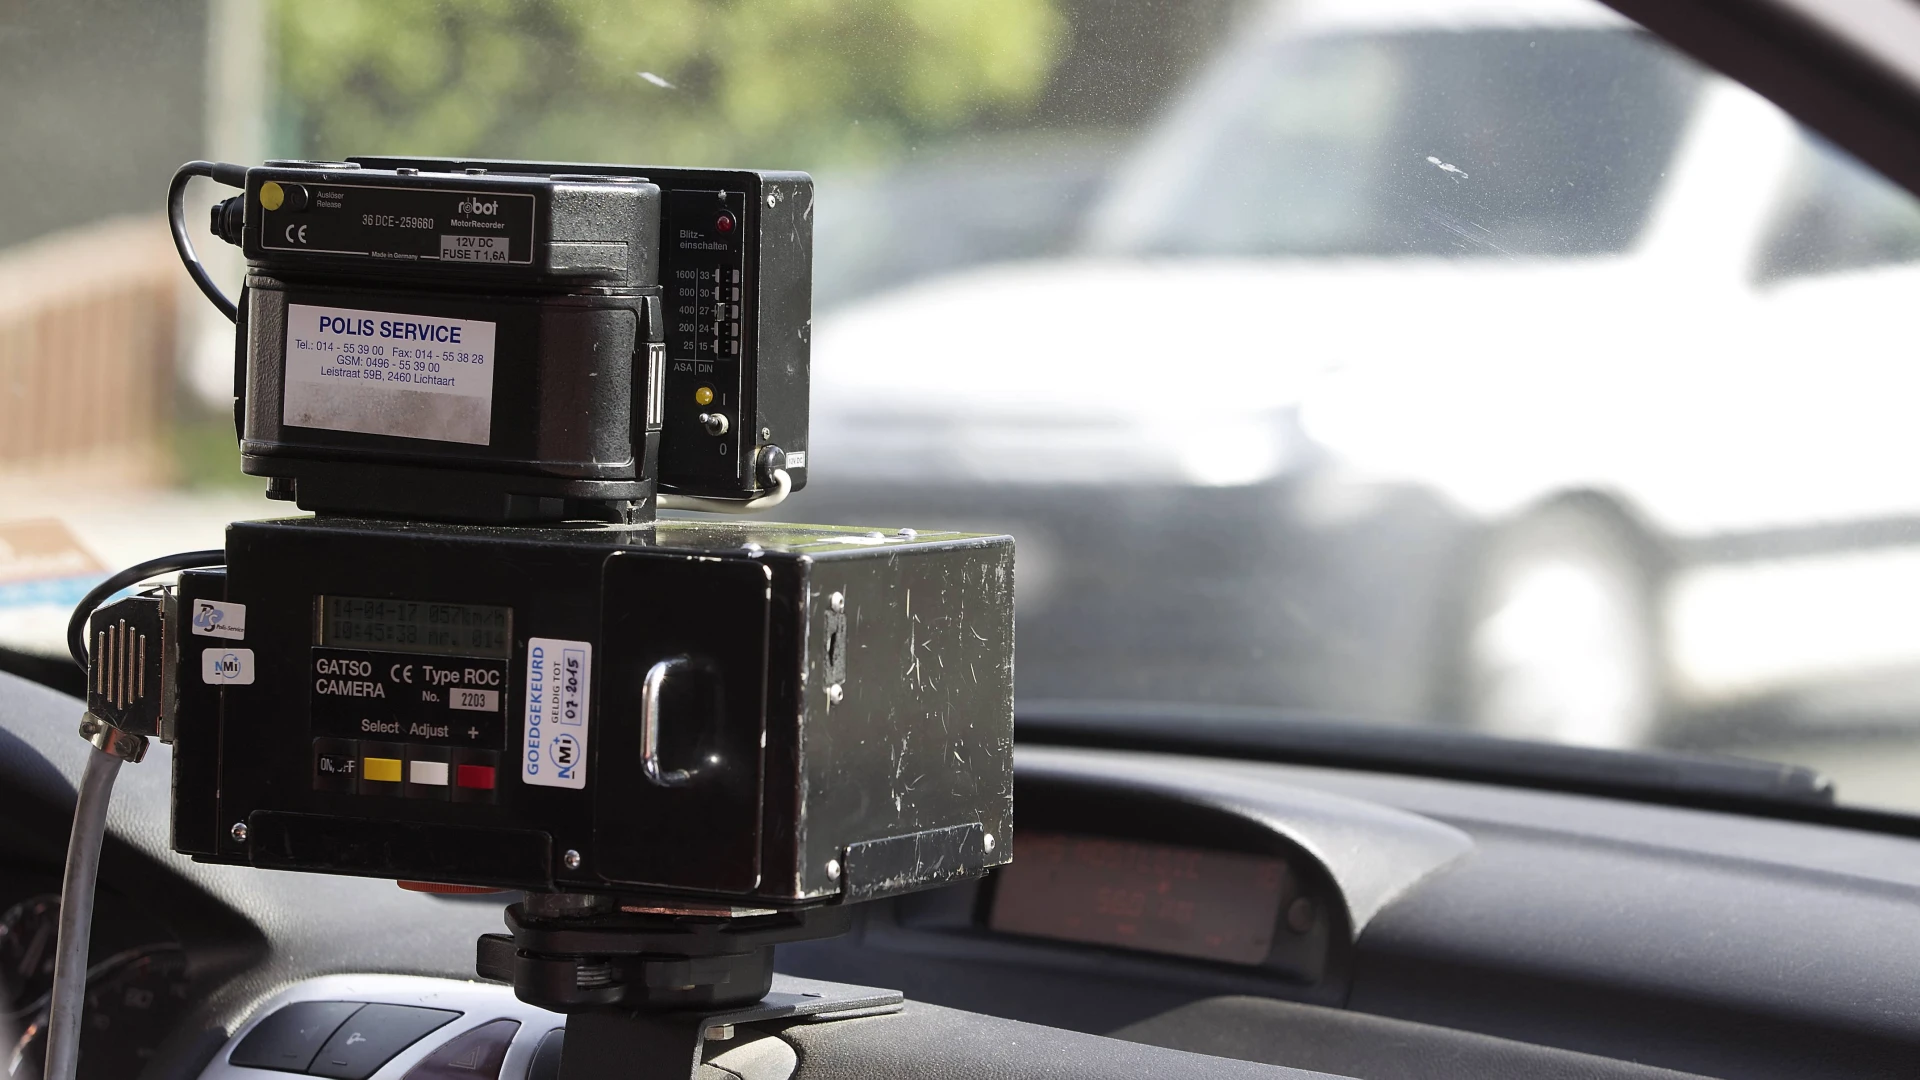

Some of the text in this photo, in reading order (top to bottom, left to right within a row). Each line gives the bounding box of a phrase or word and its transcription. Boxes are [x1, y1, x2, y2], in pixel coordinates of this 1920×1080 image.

[316, 191, 344, 200] Auslöser
[316, 200, 342, 208] Release
[458, 196, 498, 217] robot
[362, 214, 374, 226] 36
[450, 219, 504, 229] MotorRecorder
[456, 238, 494, 248] 12V DC
[680, 242, 728, 251] einschalten
[394, 252, 418, 260] Germany
[442, 249, 506, 262] FUSE T 1,6A
[676, 270, 710, 280] 1600 33
[679, 288, 710, 298] 800 30
[678, 306, 710, 315] 400 27
[319, 316, 462, 344] POLIS SERVICE
[678, 324, 709, 332] 200 24
[316, 341, 334, 352] 014
[344, 344, 354, 354] 55
[358, 344, 370, 354] 39
[372, 346, 384, 356] 00
[684, 342, 708, 350] 25 15
[392, 347, 412, 358] Fax:
[415, 349, 432, 360] 014
[442, 352, 454, 362] 55
[457, 352, 468, 363] 38
[472, 354, 484, 364] 28
[336, 354, 363, 366] GSM:
[366, 358, 390, 368] 0496
[398, 360, 410, 370] 55
[414, 362, 426, 372] 39
[428, 362, 440, 372] 00
[674, 363, 713, 373] ASA DIN
[320, 366, 455, 386] Leistraat 59B, 2460 Lichtaart
[316, 658, 372, 677] GATSO
[422, 666, 500, 686] Type ROC
[316, 679, 386, 698] CAMERA
[551, 662, 562, 724] GELDIG TOT
[422, 690, 440, 702] No.
[461, 692, 486, 708] 2203
[527, 646, 544, 776] GOEDGEKEURD
[361, 718, 400, 734] Select
[409, 722, 449, 739] Adjust
